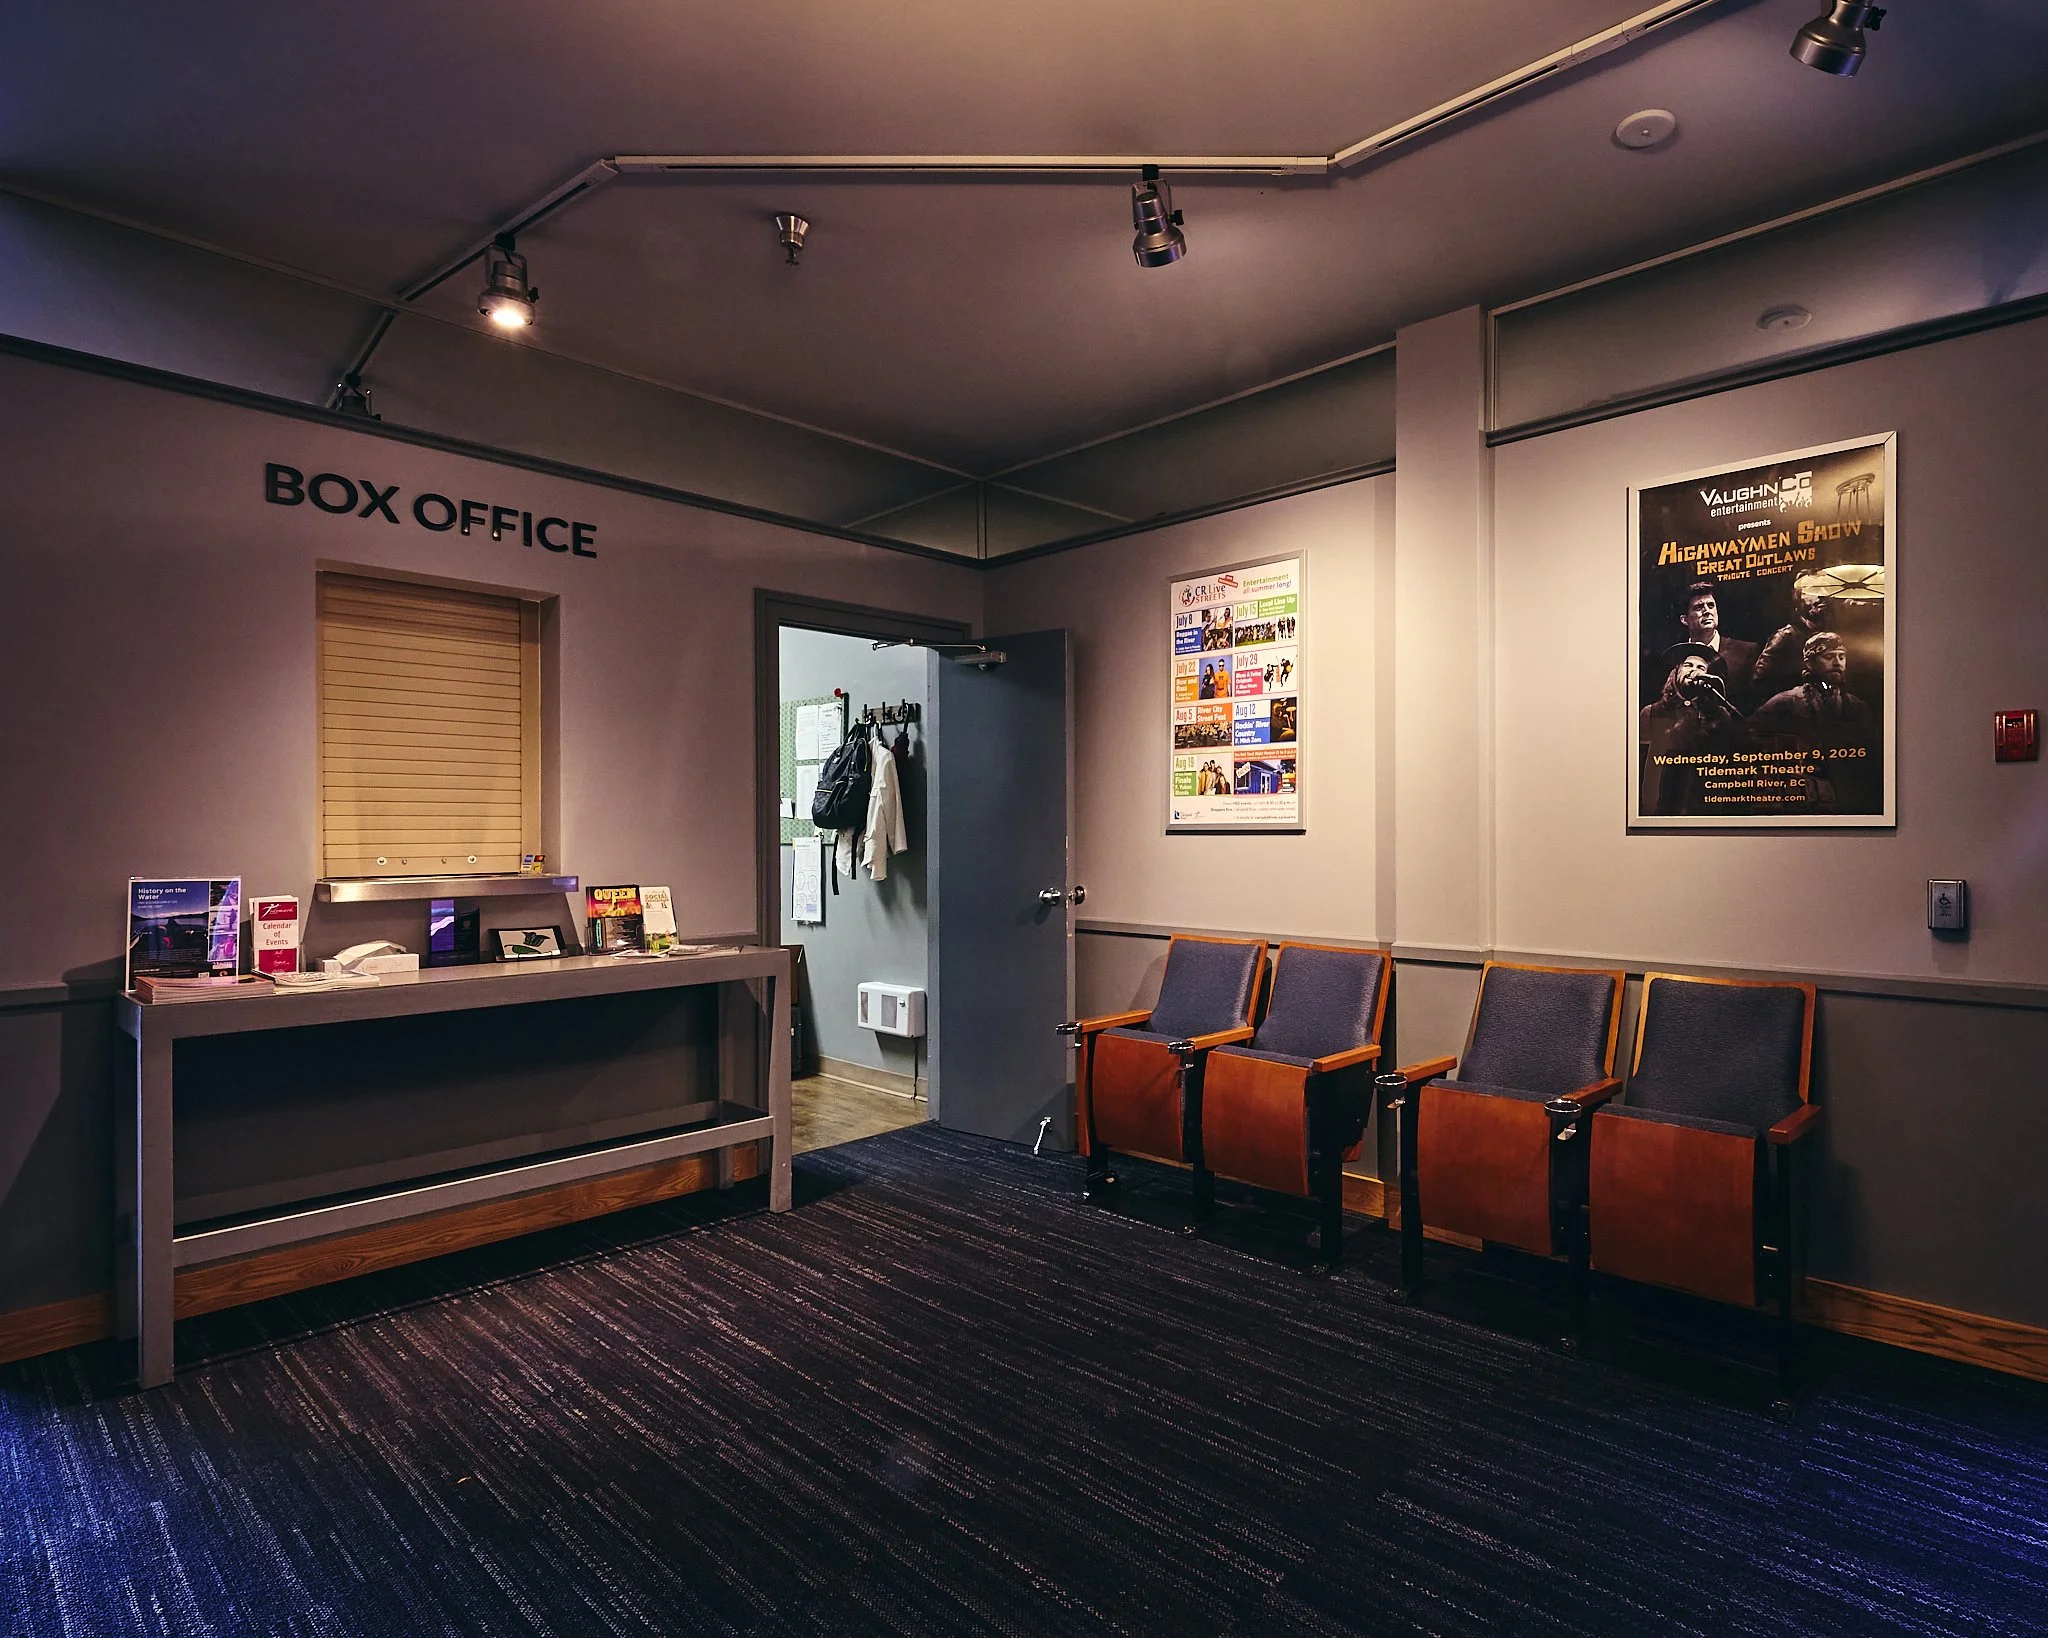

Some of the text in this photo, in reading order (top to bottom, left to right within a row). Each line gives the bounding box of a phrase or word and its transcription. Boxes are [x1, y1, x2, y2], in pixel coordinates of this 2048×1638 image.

[265, 462, 597, 559] BOX OFFICE
[1710, 497, 1779, 518] entertainment
[1738, 519, 1771, 532] presents
[1797, 520, 1862, 545] SHOW
[1696, 547, 1816, 575] GREAT OUTLAWS
[1756, 564, 1793, 577] CONCERT
[1243, 573, 1289, 588] Entertainment
[1251, 584, 1276, 593] summer
[1276, 580, 1292, 589] long!
[1195, 584, 1226, 597] CR Live
[1195, 593, 1226, 604] STREETS
[1236, 604, 1249, 620] July
[1250, 602, 1257, 615] 15
[1176, 613, 1193, 628] July 8
[1176, 660, 1196, 676] July 22
[1236, 653, 1258, 670] July 29
[1176, 708, 1193, 722] Aug 5
[1236, 703, 1256, 718] Aug 12
[1176, 756, 1195, 770] Aug 19
[1653, 748, 1867, 766] Wednesday, September 9, 2026
[1696, 764, 1815, 777] Tidemark Theatre
[1704, 778, 1807, 789] Campbell River, BC
[1704, 794, 1806, 803] tidemarktheatre.com
[594, 887, 637, 901] QUEEN
[273, 930, 281, 938] of
